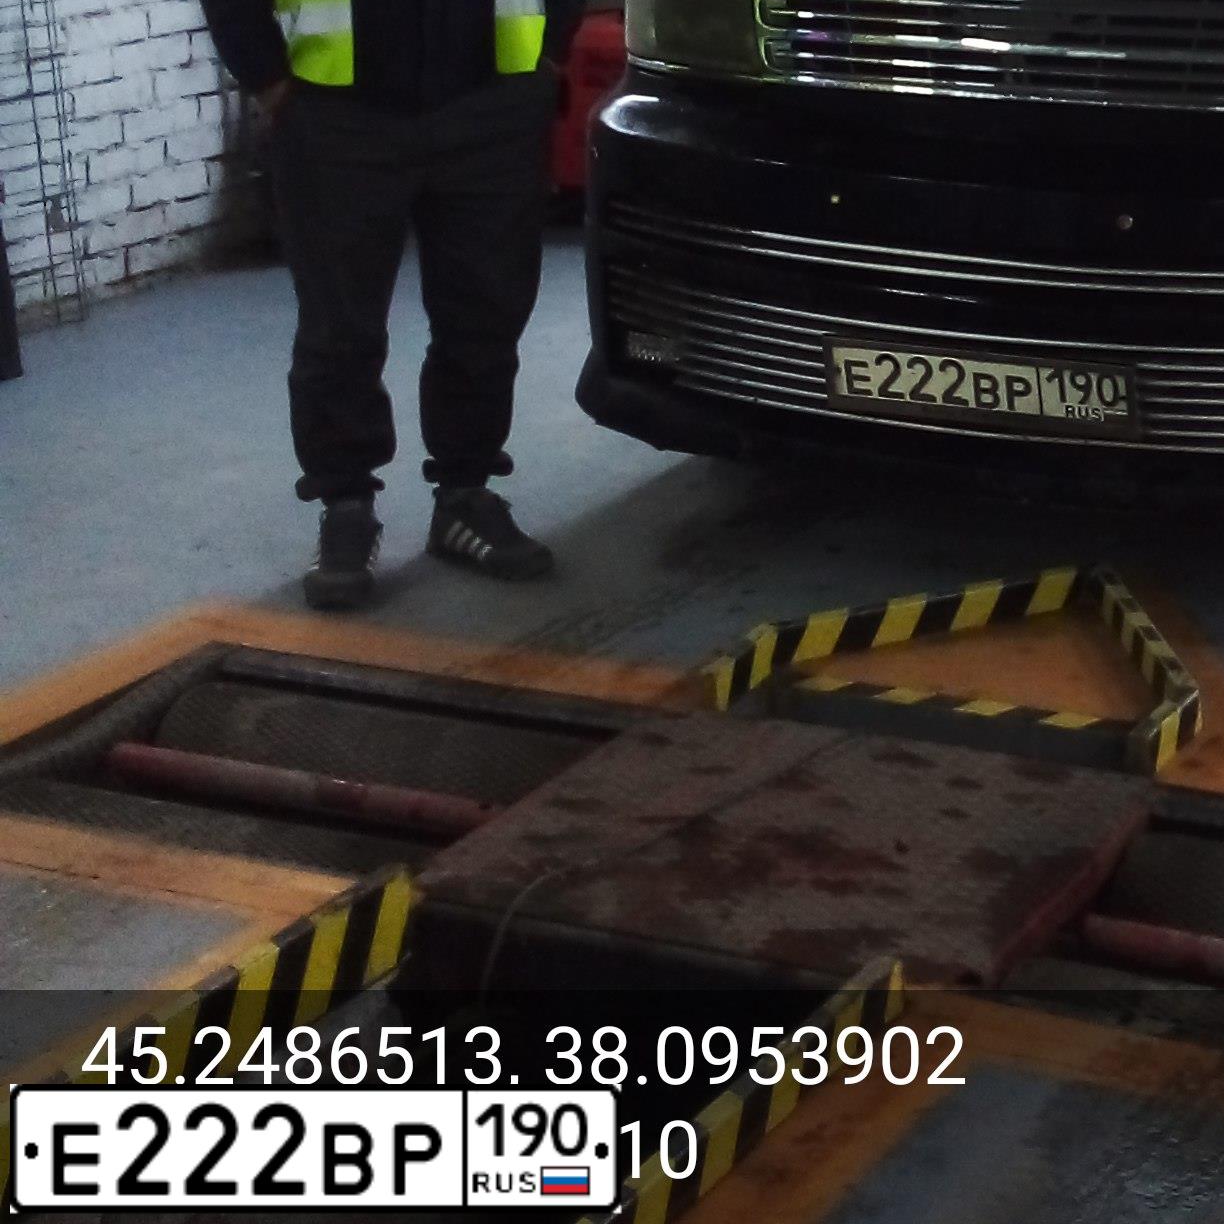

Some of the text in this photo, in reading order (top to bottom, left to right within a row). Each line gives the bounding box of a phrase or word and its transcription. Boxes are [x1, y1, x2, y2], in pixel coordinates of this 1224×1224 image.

[844, 351, 1120, 411] Е222ВР 190
[1064, 404, 1105, 422] RUS
